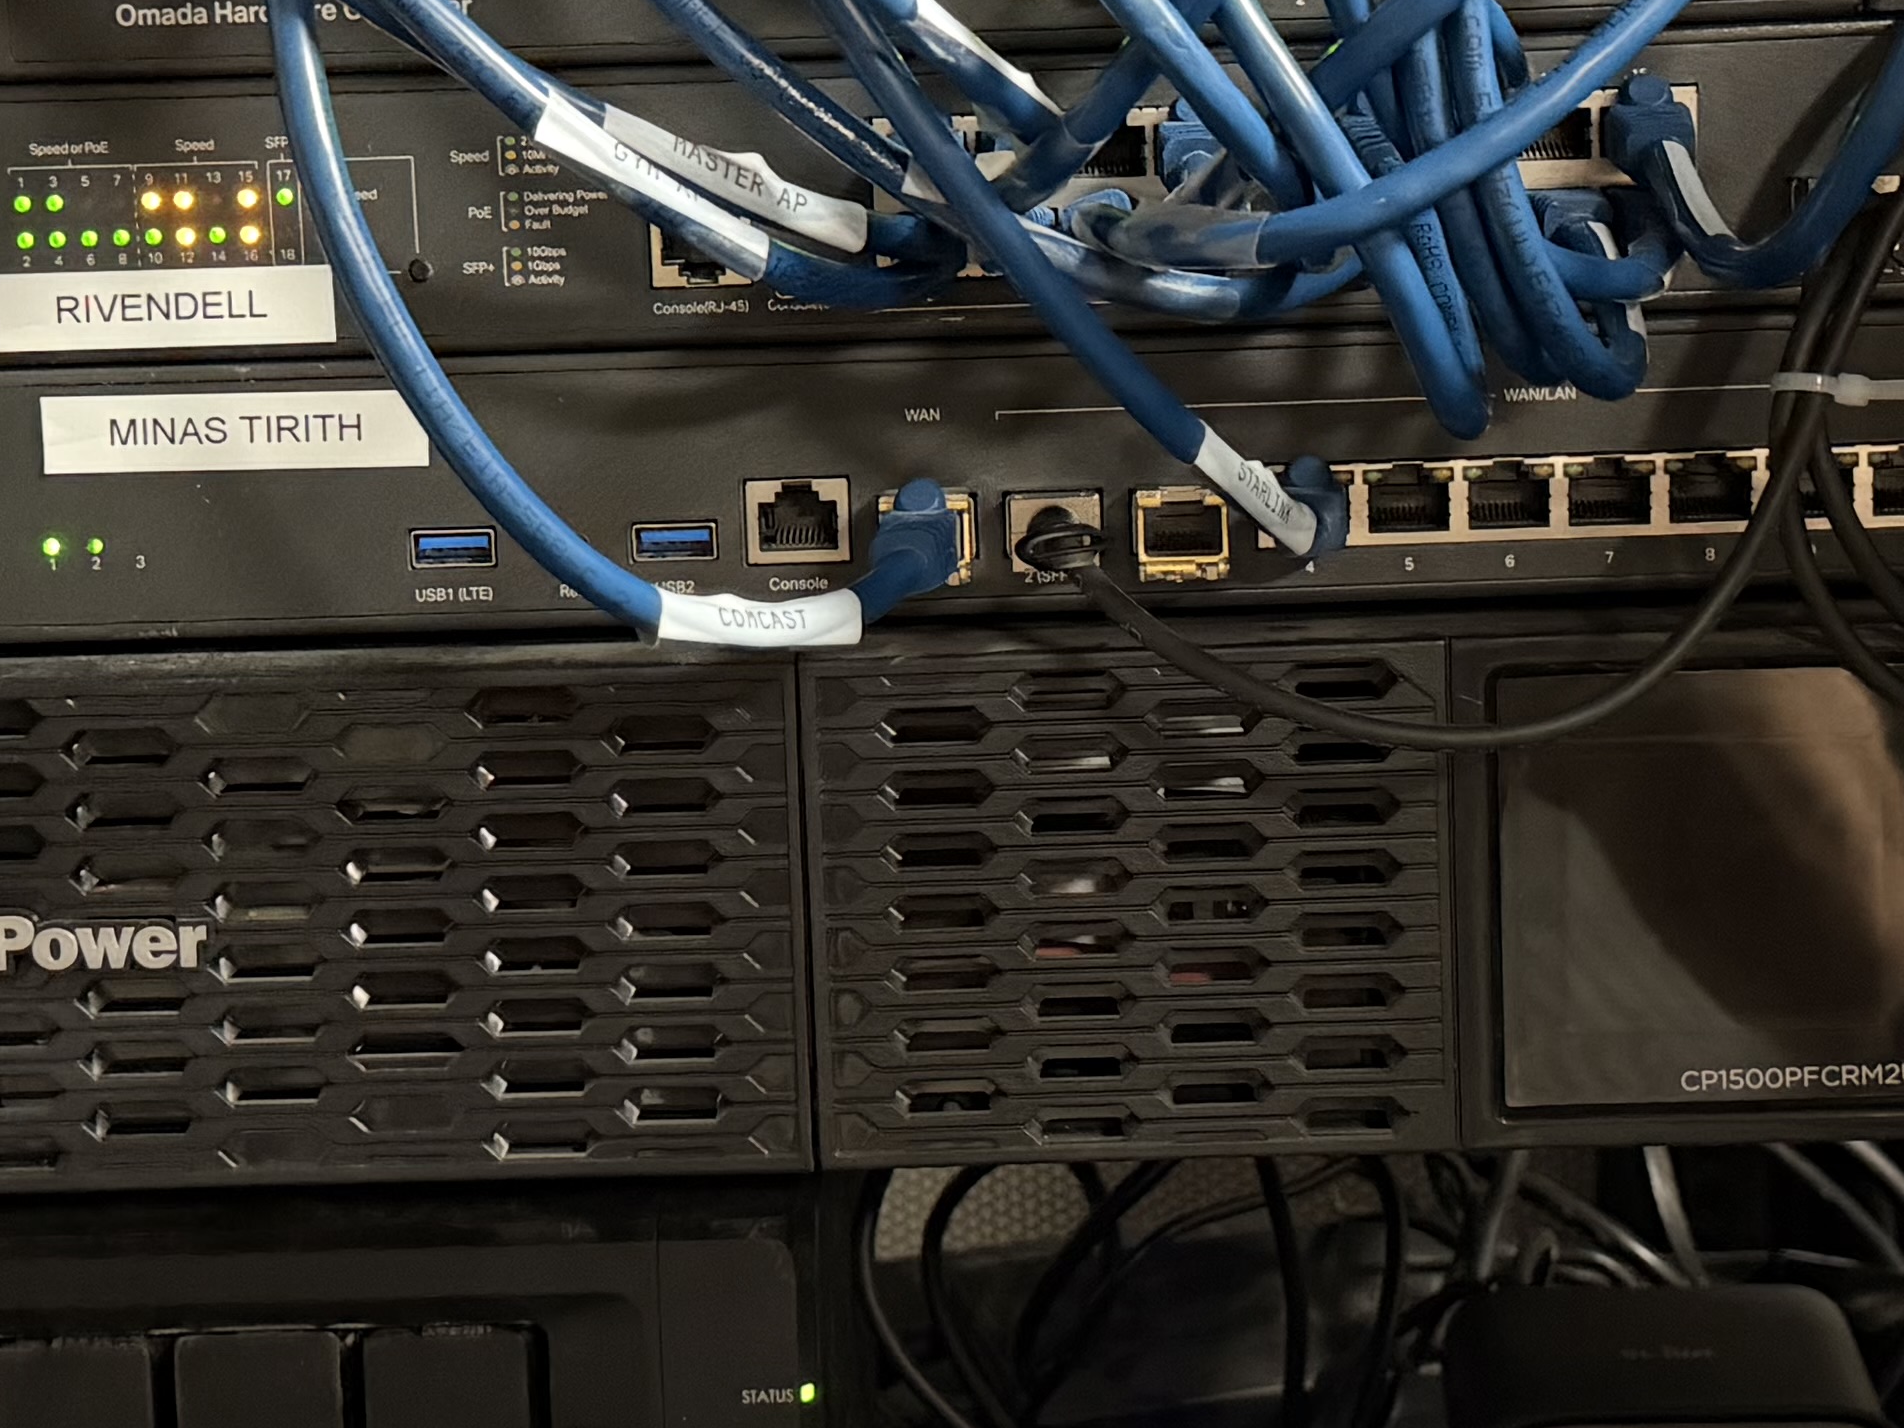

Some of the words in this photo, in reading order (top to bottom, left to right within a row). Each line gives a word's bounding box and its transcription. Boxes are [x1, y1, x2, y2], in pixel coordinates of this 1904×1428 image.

[115, 4, 208, 26] Omada
[213, 0, 336, 25] Harre
[29, 143, 68, 156] Speed
[71, 144, 83, 154] or
[85, 141, 108, 153] PoE
[175, 139, 214, 152] Speed
[450, 150, 490, 165] Speed
[523, 165, 559, 176] Activity
[673, 136, 765, 196] MASTER
[777, 188, 808, 213] AP
[18, 177, 24, 189] 1
[49, 176, 58, 188] 3
[81, 175, 89, 187] 5
[113, 175, 121, 187] 7
[145, 173, 154, 185] 9
[175, 173, 189, 184] 11
[206, 172, 222, 184] 13
[238, 171, 254, 183] 15
[276, 170, 291, 182] 17
[524, 191, 574, 203] Delivering
[577, 190, 608, 200] Power
[468, 207, 492, 219] PoE
[525, 206, 549, 215] Over
[552, 205, 589, 217] Budget
[525, 220, 551, 229] Fault
[23, 256, 32, 267] 2
[54, 255, 63, 267] 4
[86, 254, 95, 266] 6
[118, 253, 127, 265] 8
[149, 252, 163, 264] 10
[180, 251, 195, 263] 12
[212, 251, 227, 262] 14
[245, 250, 259, 262] 16
[281, 249, 296, 261] 18
[463, 263, 495, 274] SFP+
[528, 261, 560, 272] 1Gbps
[528, 275, 565, 286] Activity
[56, 291, 268, 325] RIVENDELL
[1503, 386, 1577, 403] WAN/LAN
[904, 407, 941, 423] WAN
[110, 415, 228, 448] MINAS
[239, 412, 363, 445] TIRITH
[50, 558, 56, 570] 1
[92, 557, 102, 570] 2
[135, 556, 145, 570] 3
[1405, 557, 1414, 571] 5
[1505, 554, 1515, 568] 6
[1605, 551, 1614, 564] 7
[1705, 548, 1716, 561] 8
[768, 575, 829, 592] Console
[415, 588, 453, 602] USB1
[458, 587, 494, 601] (LTE)
[718, 606, 809, 632] COMCAST
[742, 1388, 794, 1404] STATUS
